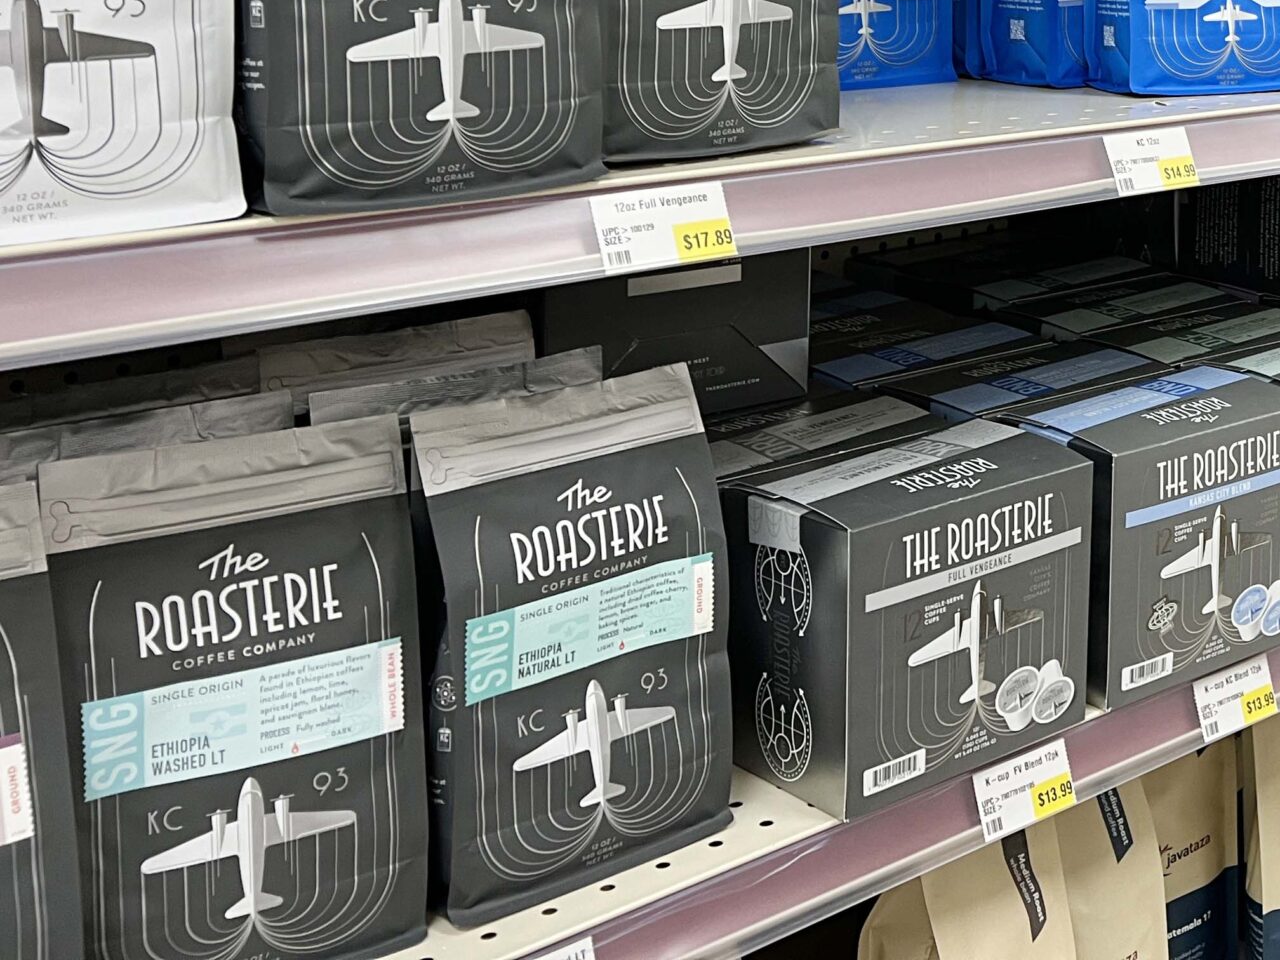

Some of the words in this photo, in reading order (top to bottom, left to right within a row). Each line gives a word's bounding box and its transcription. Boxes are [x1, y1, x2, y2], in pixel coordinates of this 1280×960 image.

[1164, 163, 1196, 181] $14.99
[614, 202, 637, 214] 12oz
[639, 199, 657, 210] Full
[660, 193, 708, 208] Vengeance
[602, 227, 620, 238] UPC
[604, 236, 623, 246] SIZE
[683, 228, 733, 251] $17.89
[1156, 456, 1189, 500] THE
[1193, 430, 1280, 490] ROASTERIE
[557, 478, 613, 511] The
[510, 495, 669, 584] ROASTERIE
[902, 527, 941, 578] THE
[947, 493, 1054, 565] ROASTERIE
[199, 544, 270, 581] The
[541, 573, 589, 594] COFFEE
[594, 555, 649, 579] COMPANY
[969, 553, 1013, 574] VENGEANCE
[135, 563, 343, 658] ROASTERIE
[924, 607, 946, 619] COFFEE
[924, 616, 940, 626] CUPS
[172, 649, 236, 671] COFFEE
[242, 632, 317, 658] COMPANY
[470, 619, 511, 694] SNG
[518, 642, 562, 666] ETHIOPIA
[518, 657, 562, 679] NATURAL
[565, 651, 576, 665] LT
[388, 652, 397, 683] BEAN
[151, 687, 195, 706] SINGLE
[198, 679, 244, 696] ORIGIN
[389, 686, 398, 720] WHOLE
[1246, 691, 1275, 714] $13.99
[90, 701, 138, 792] SNG
[151, 736, 210, 760] ETHIOPIA
[260, 742, 285, 754] LIGHT
[10, 765, 20, 815] GROUND
[312, 767, 349, 795] 93
[1037, 780, 1073, 807] $13.99
[147, 806, 184, 836] KC
[1165, 834, 1211, 869] javataza
